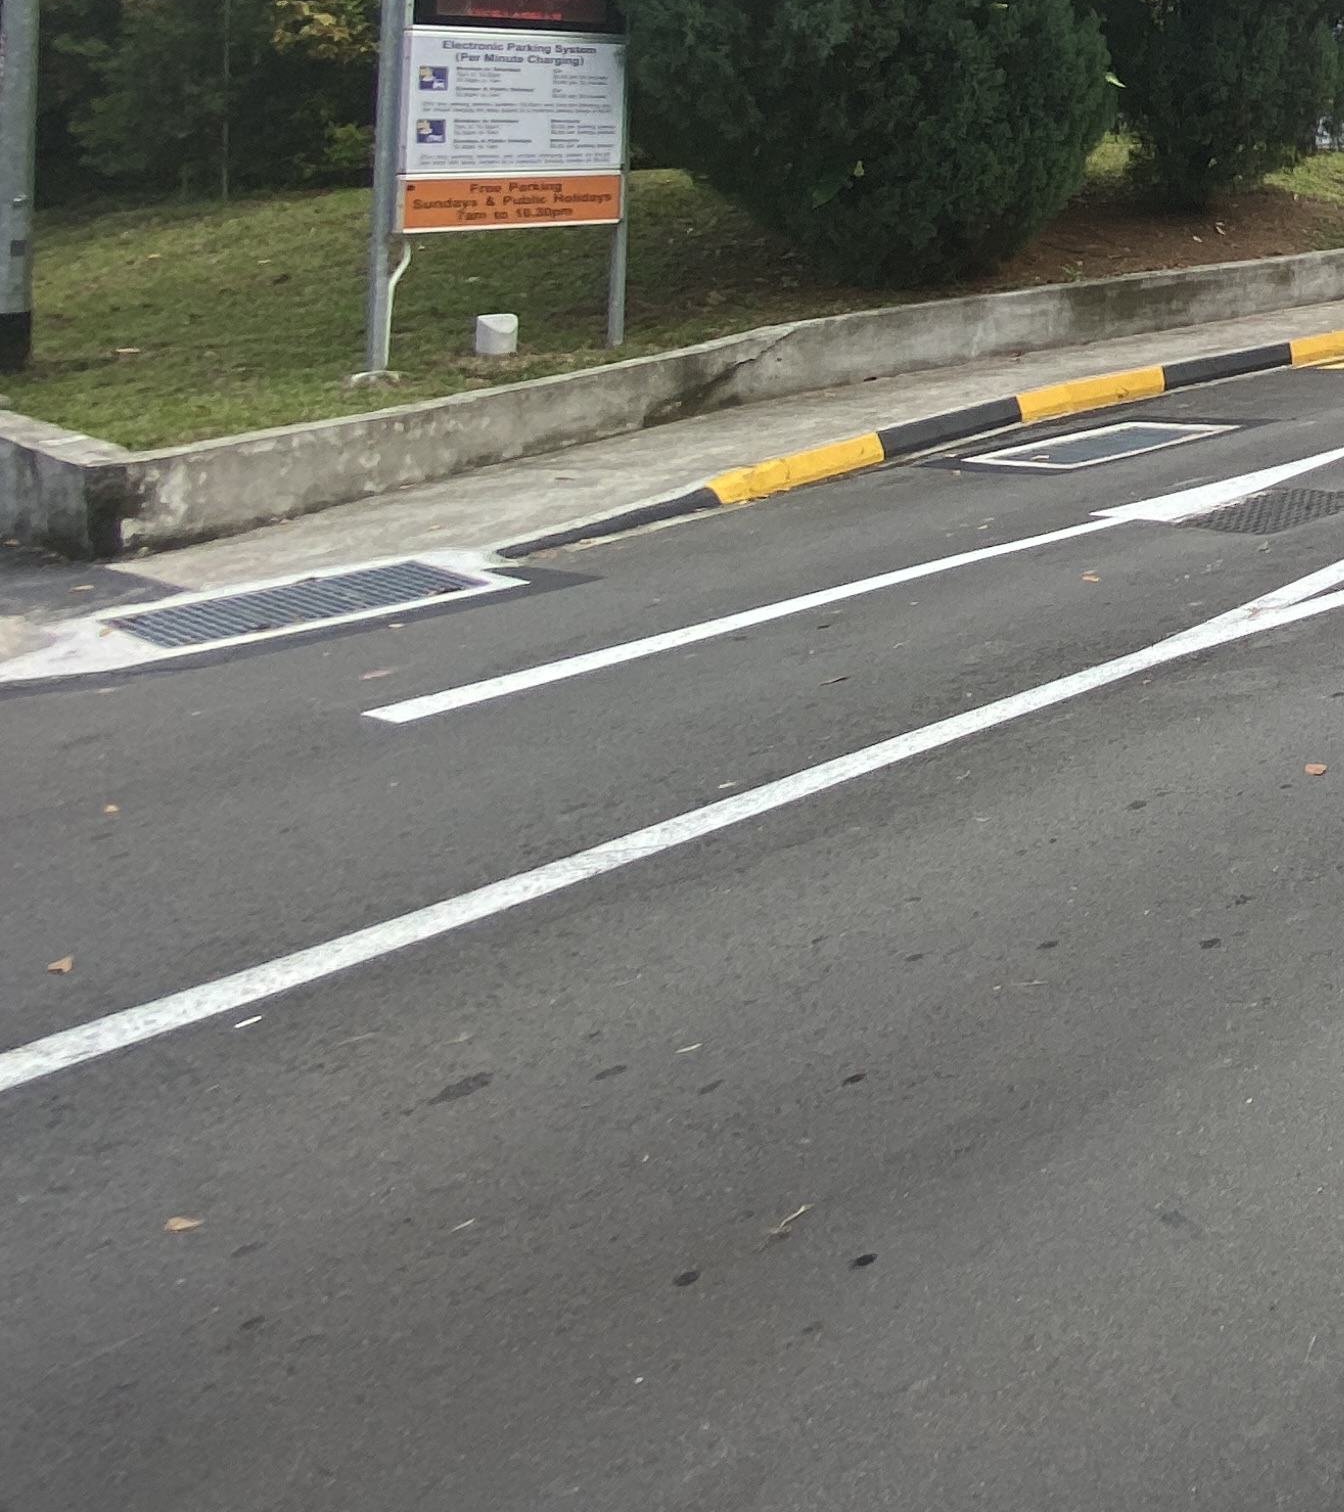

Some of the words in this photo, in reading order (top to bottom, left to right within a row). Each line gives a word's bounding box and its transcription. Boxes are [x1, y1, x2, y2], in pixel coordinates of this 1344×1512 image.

[442, 40, 504, 51] Electronic
[507, 43, 551, 54] Parking
[555, 44, 597, 54] System
[456, 52, 481, 62] (Per
[484, 54, 524, 63] Minute
[527, 55, 585, 67] Charging)
[469, 183, 501, 193] Free
[509, 182, 563, 193] Parking
[413, 198, 478, 210] Sundays
[486, 196, 495, 206] &
[503, 194, 545, 205] Public
[554, 192, 612, 204] Holidays
